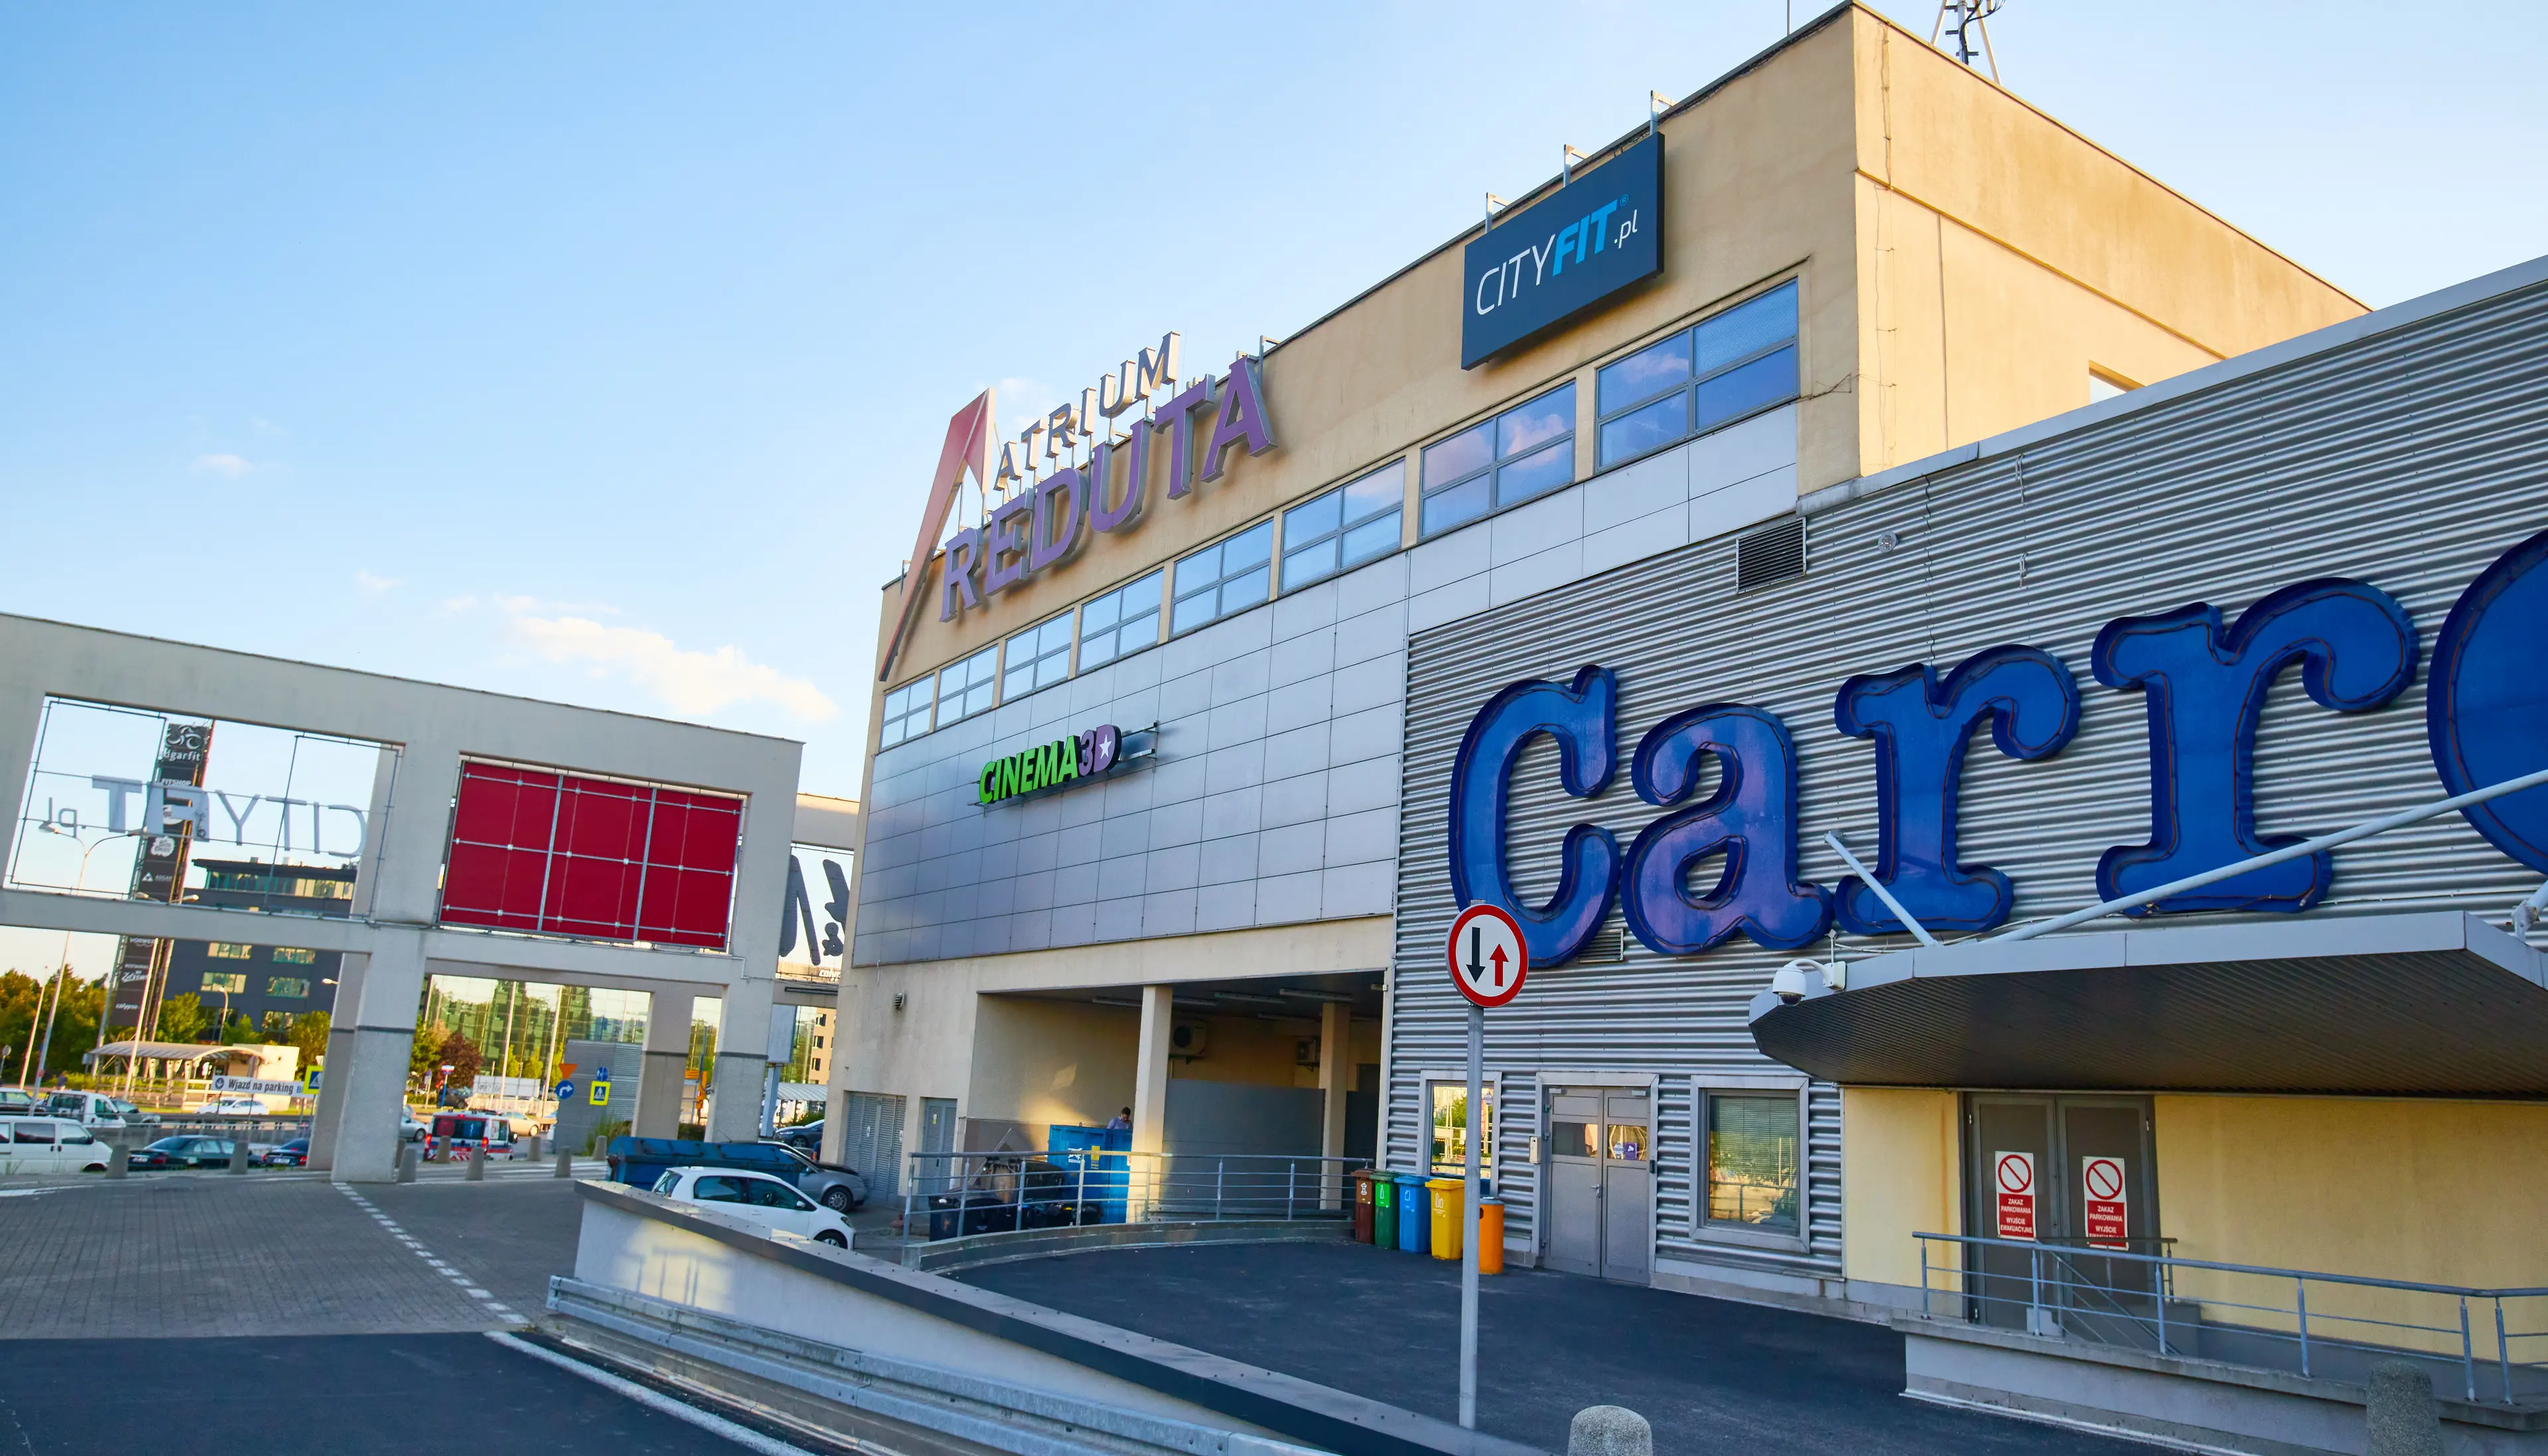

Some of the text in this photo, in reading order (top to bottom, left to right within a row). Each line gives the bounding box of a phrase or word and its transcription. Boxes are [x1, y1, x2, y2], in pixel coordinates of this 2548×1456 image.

[993, 331, 1180, 492] ATRIUM
[939, 354, 1278, 622] REDUTA
[228, 1079, 251, 1091] Wjazd
[253, 1082, 263, 1091] na
[265, 1082, 293, 1095] parking
[2001, 1205, 2032, 1214] PARKOWANIA
[2089, 1213, 2123, 1223] PARKOWANIA
[2000, 1224, 2033, 1234] EWAKUACYJNE
